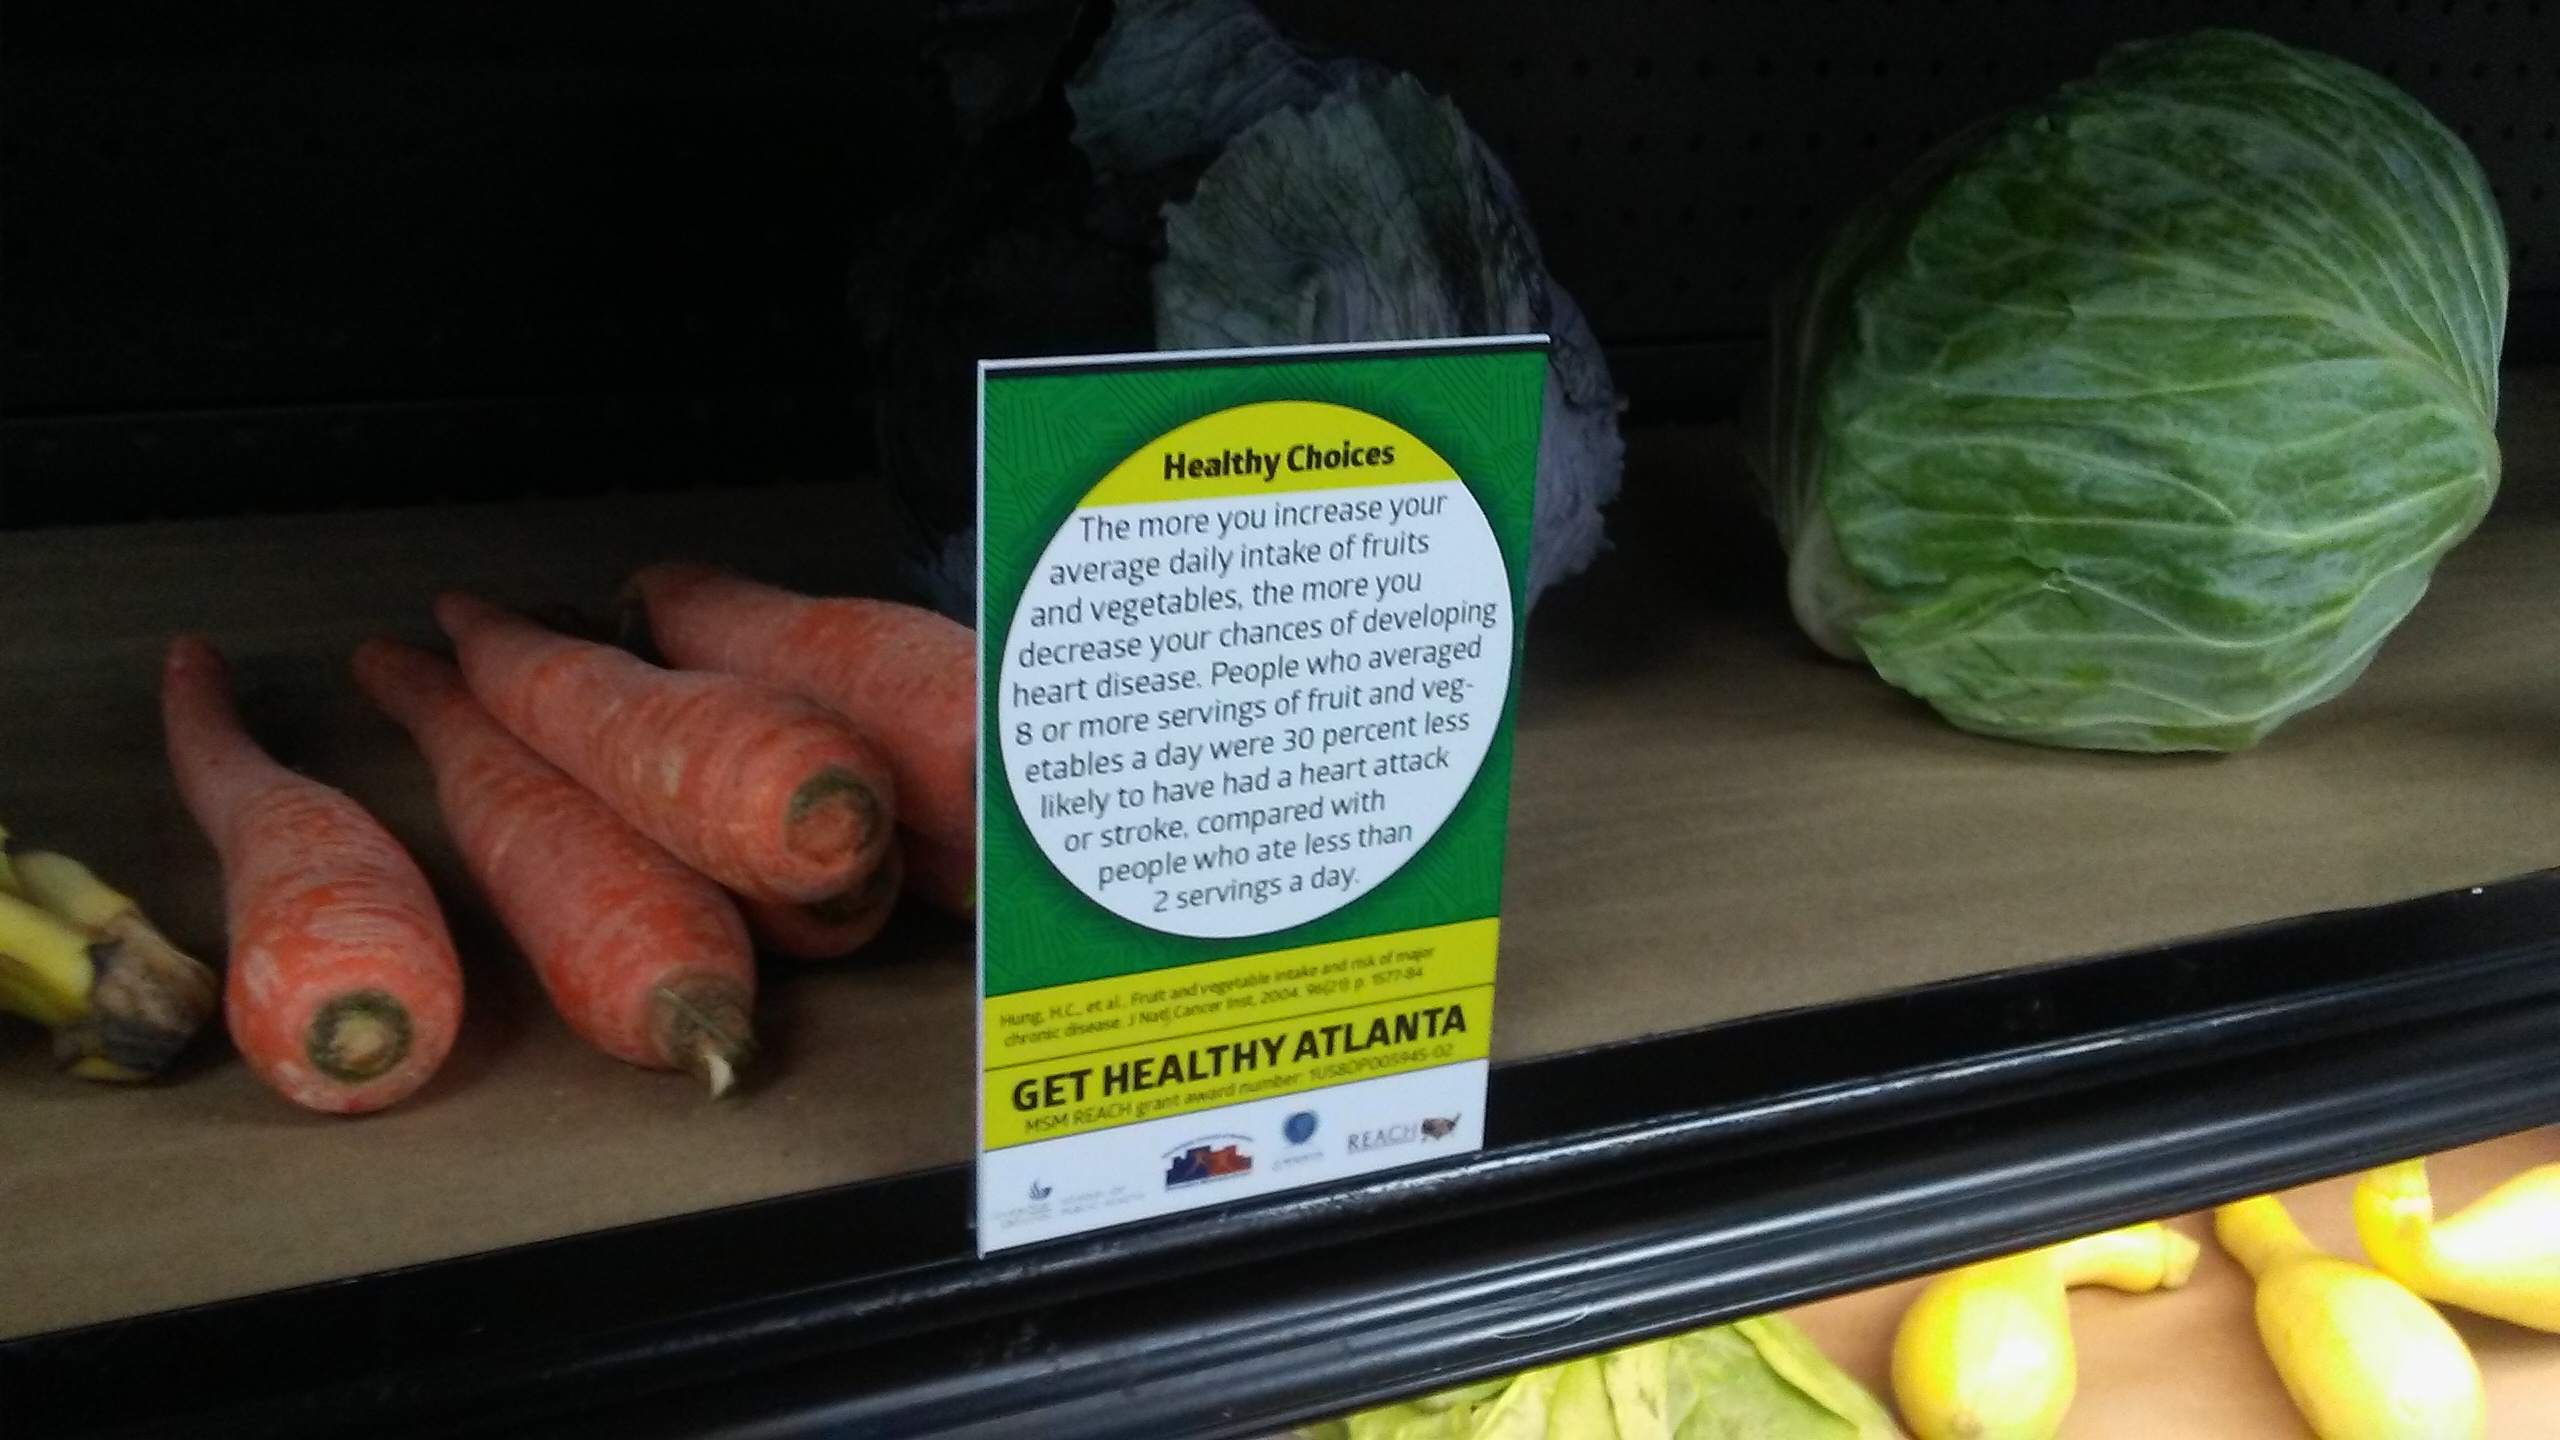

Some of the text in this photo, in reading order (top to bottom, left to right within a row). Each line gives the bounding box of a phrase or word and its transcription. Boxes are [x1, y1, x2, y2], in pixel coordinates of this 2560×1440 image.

[1164, 440, 1395, 481] Healthy Choices
[1078, 494, 1448, 543] The more you increase your
[1049, 530, 1430, 586] average daily intake of fruits
[1030, 572, 1422, 628] and vegetables, the more you
[1018, 600, 1498, 668] decrease your chances of developing
[1013, 633, 1483, 708] heart disease. People who averaged
[1015, 676, 1474, 746] 8 or more servings of fruit and veg-
[1025, 711, 1470, 784] etables a day were 30 percent less
[1041, 745, 1449, 819] likely to have had a heart attack
[1063, 788, 1386, 853] or stroke, compared with
[1098, 823, 1412, 891] people who ate less than
[1152, 865, 1359, 913] 2 servings a day.
[1130, 989, 1167, 1006] Fruit
[1169, 982, 1198, 1000] and
[1200, 972, 1271, 996] vegetable
[1274, 965, 1319, 982] intake
[1321, 959, 1348, 975] and
[1351, 955, 1376, 970] risk
[1379, 951, 1394, 966] of
[1395, 947, 1435, 963] major
[1004, 1028, 1059, 1047] chronic
[1173, 1001, 1223, 1019] Cancer
[1012, 1004, 1466, 1112] GET HEALTHY ATLANTA
[1025, 1113, 1069, 1134] MSM
[1072, 1101, 1133, 1125] REACH
[1135, 1094, 1181, 1117] grant
[1185, 1083, 1237, 1104] award
[1348, 1124, 1418, 1151] REACH
